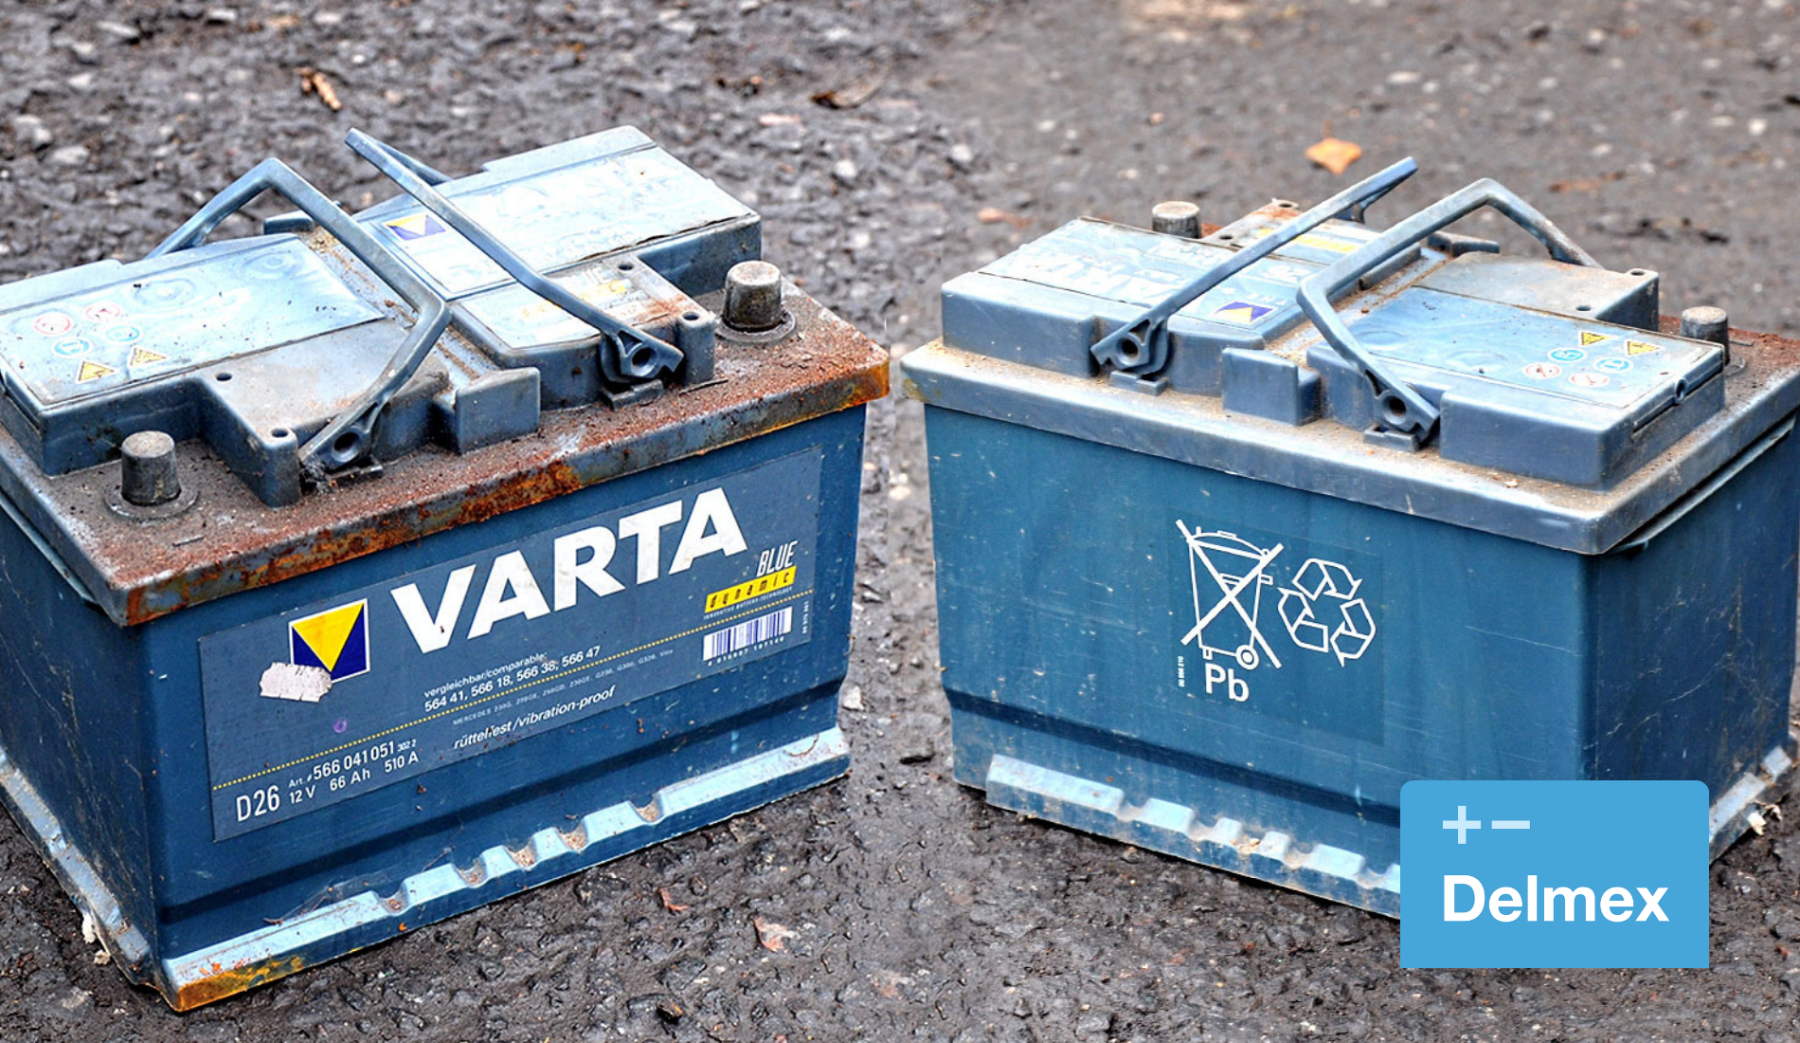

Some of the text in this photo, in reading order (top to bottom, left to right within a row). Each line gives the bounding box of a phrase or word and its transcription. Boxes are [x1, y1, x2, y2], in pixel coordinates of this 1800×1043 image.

[391, 487, 748, 654] VARTA
[756, 540, 799, 577] BLUE
[424, 652, 548, 698] vergleichbar/comparable:
[424, 645, 602, 712] 564 41, 566 18, 566 38, 566 47
[1205, 663, 1250, 702] Pb
[453, 708, 492, 725] MERCEDES
[344, 748, 369, 771] 041
[371, 741, 395, 761] 051
[290, 751, 419, 804] 12 V 66 Ah 510 A
[235, 784, 281, 822] D26
